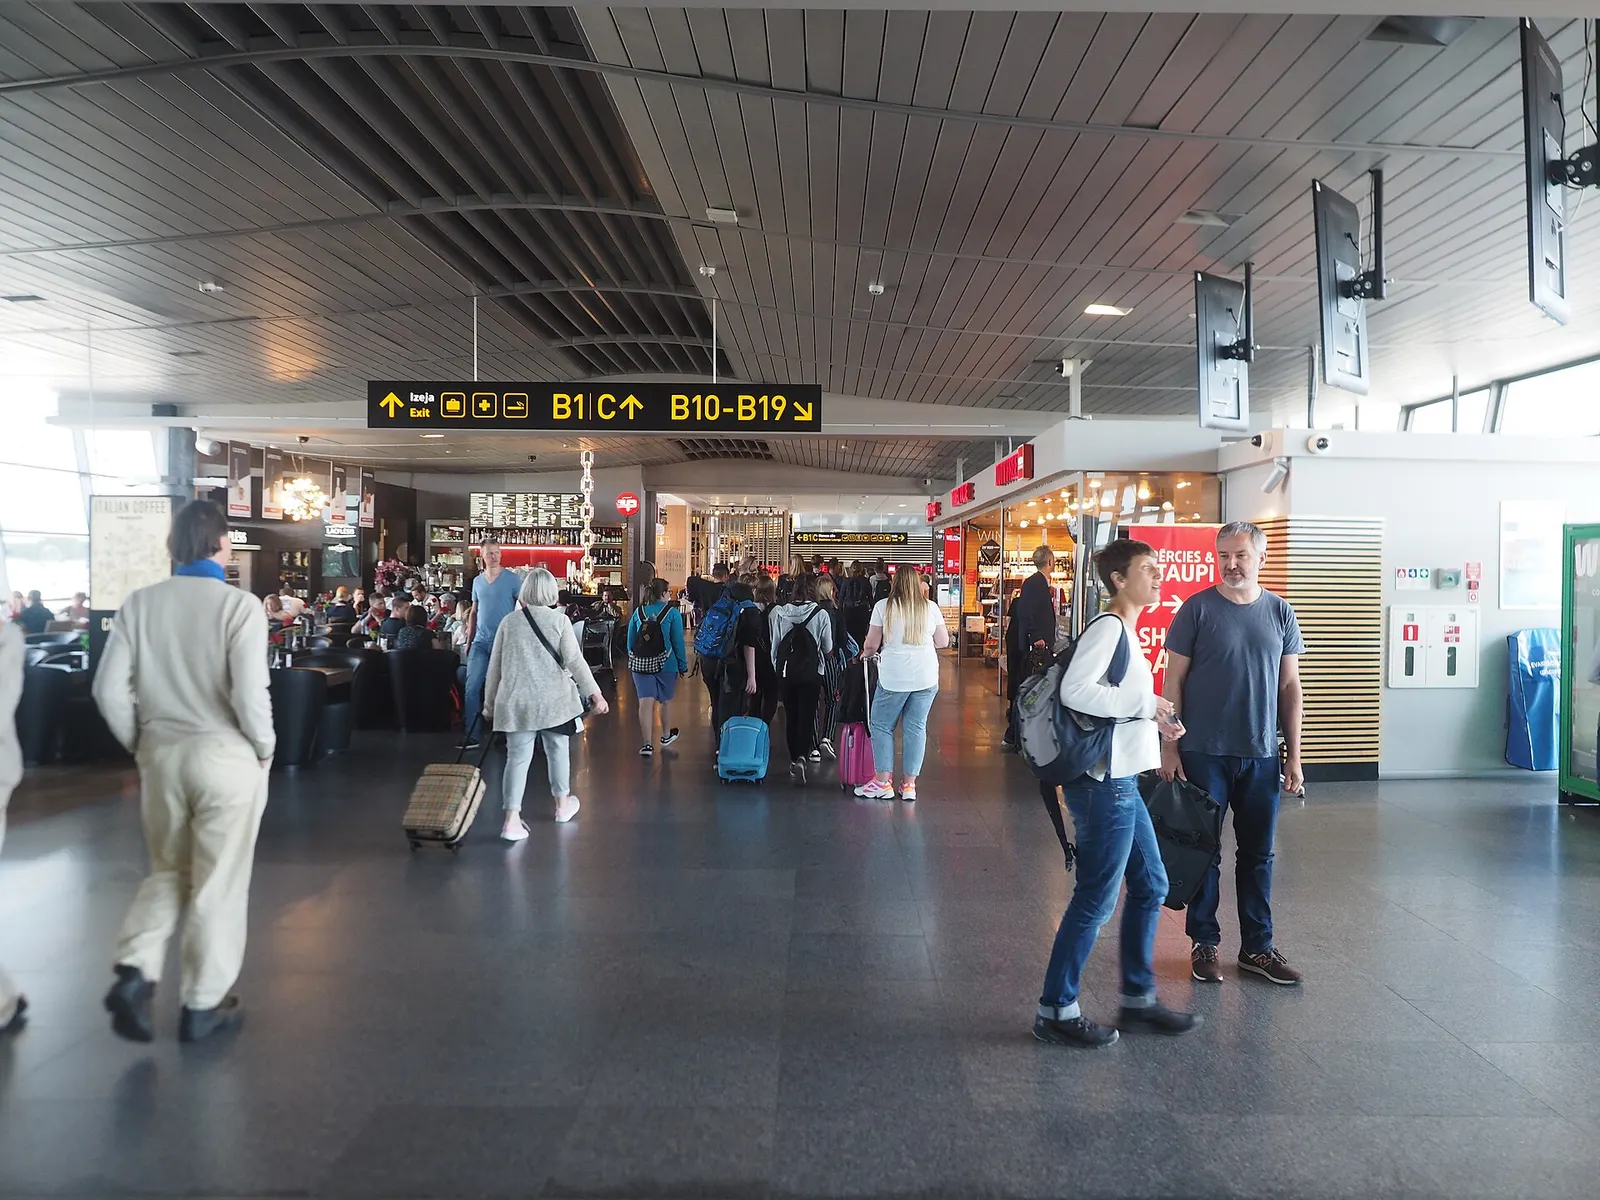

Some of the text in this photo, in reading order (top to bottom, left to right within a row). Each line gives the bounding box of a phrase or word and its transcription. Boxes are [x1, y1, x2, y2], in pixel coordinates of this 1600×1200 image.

[410, 392, 435, 404] Izeja
[553, 393, 617, 420] B1 C
[671, 394, 788, 421] B10-B19
[410, 408, 430, 418] Exit
[977, 530, 1012, 542] WINE
[1204, 551, 1215, 563] &
